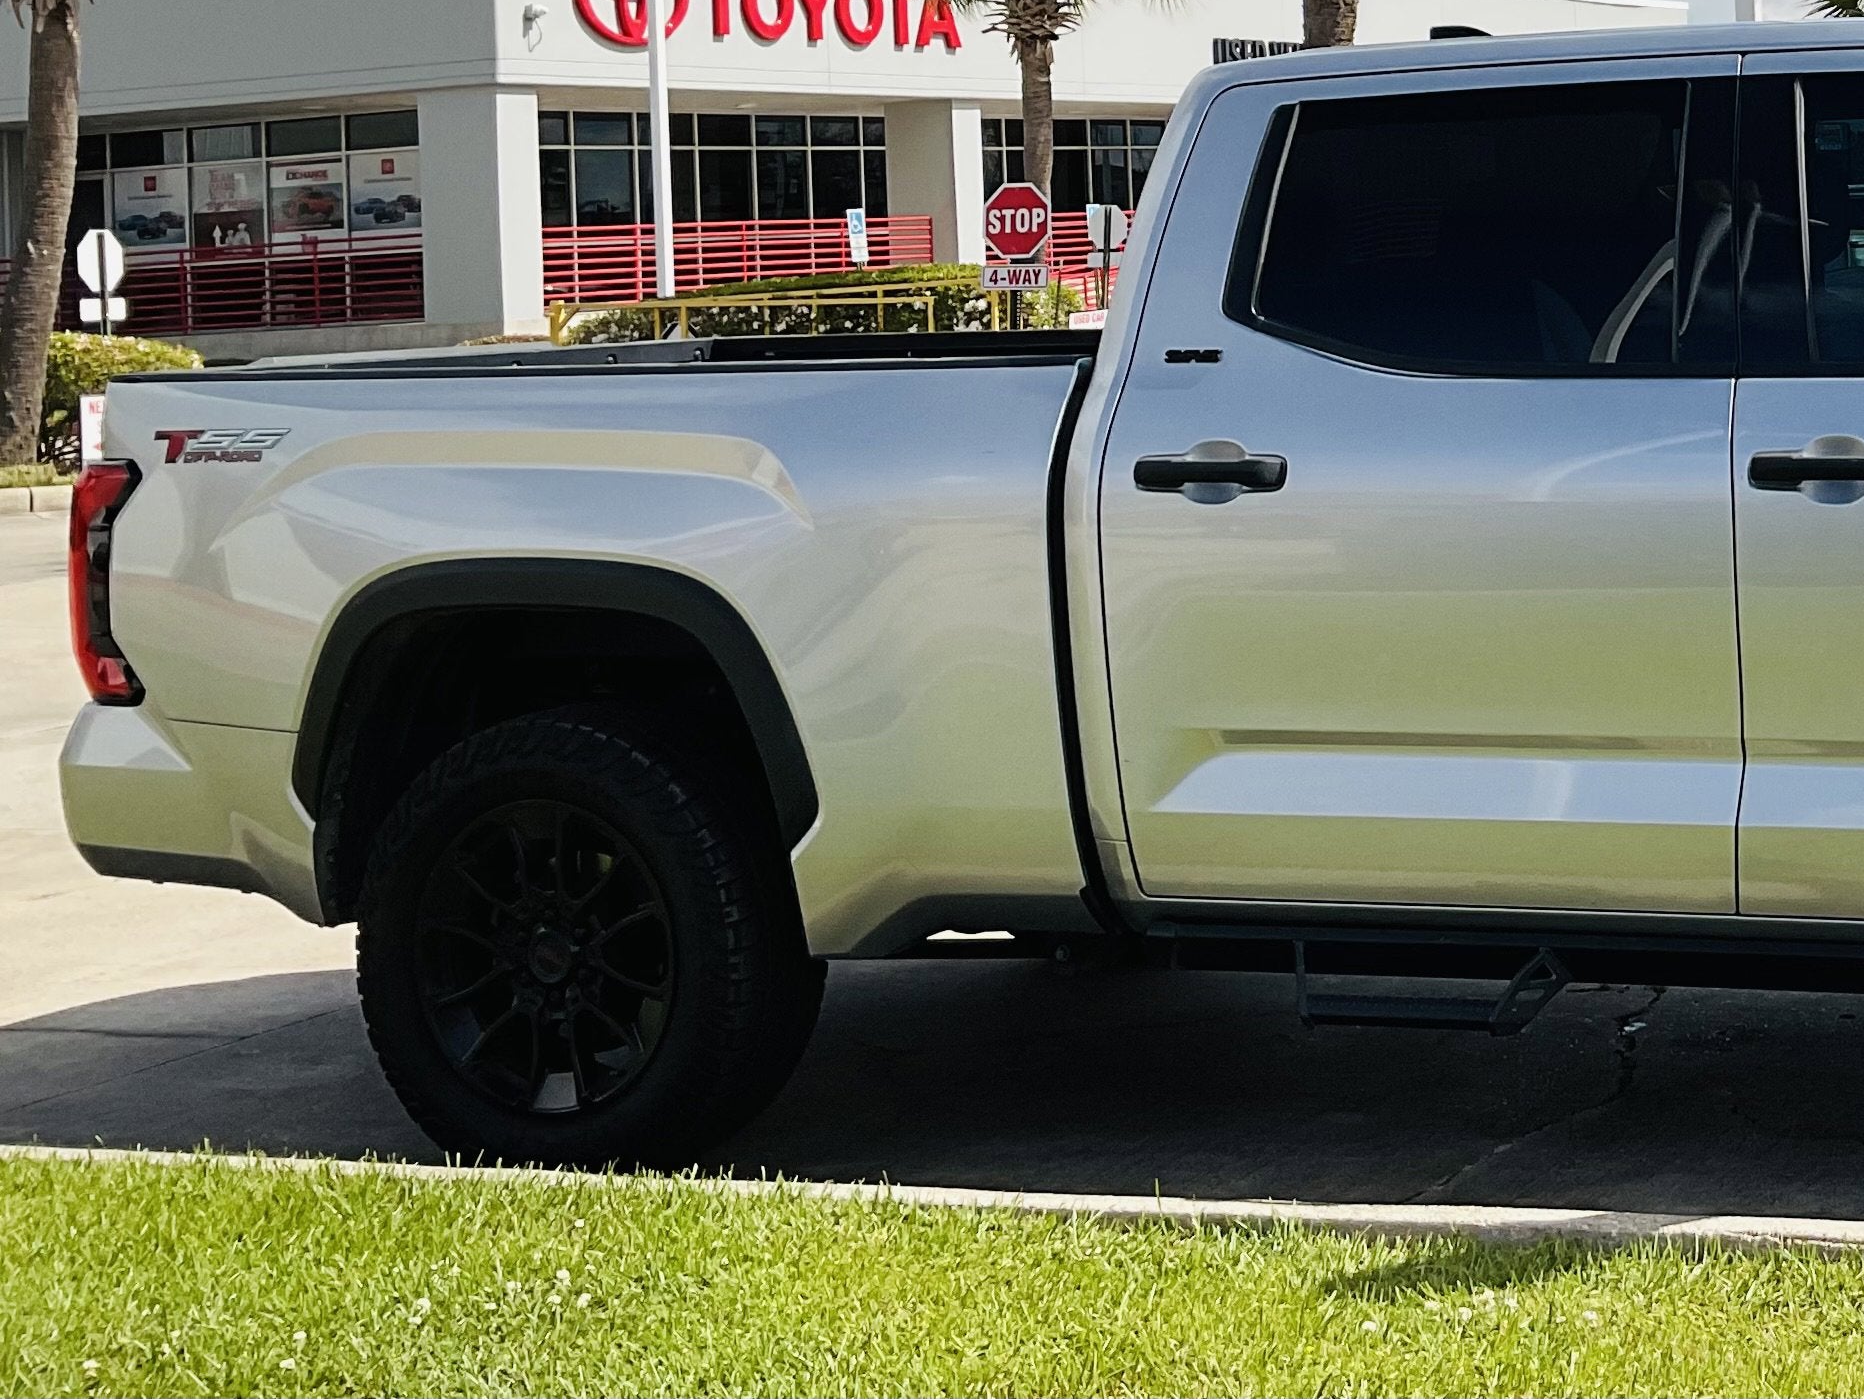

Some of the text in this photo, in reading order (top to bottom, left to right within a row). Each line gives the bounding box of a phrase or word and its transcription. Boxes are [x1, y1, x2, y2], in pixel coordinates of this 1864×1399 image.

[1212, 37, 1267, 65] USED
[987, 208, 1046, 234] STOP
[989, 269, 1042, 285] 4-WAY
[1073, 314, 1090, 324] USED
